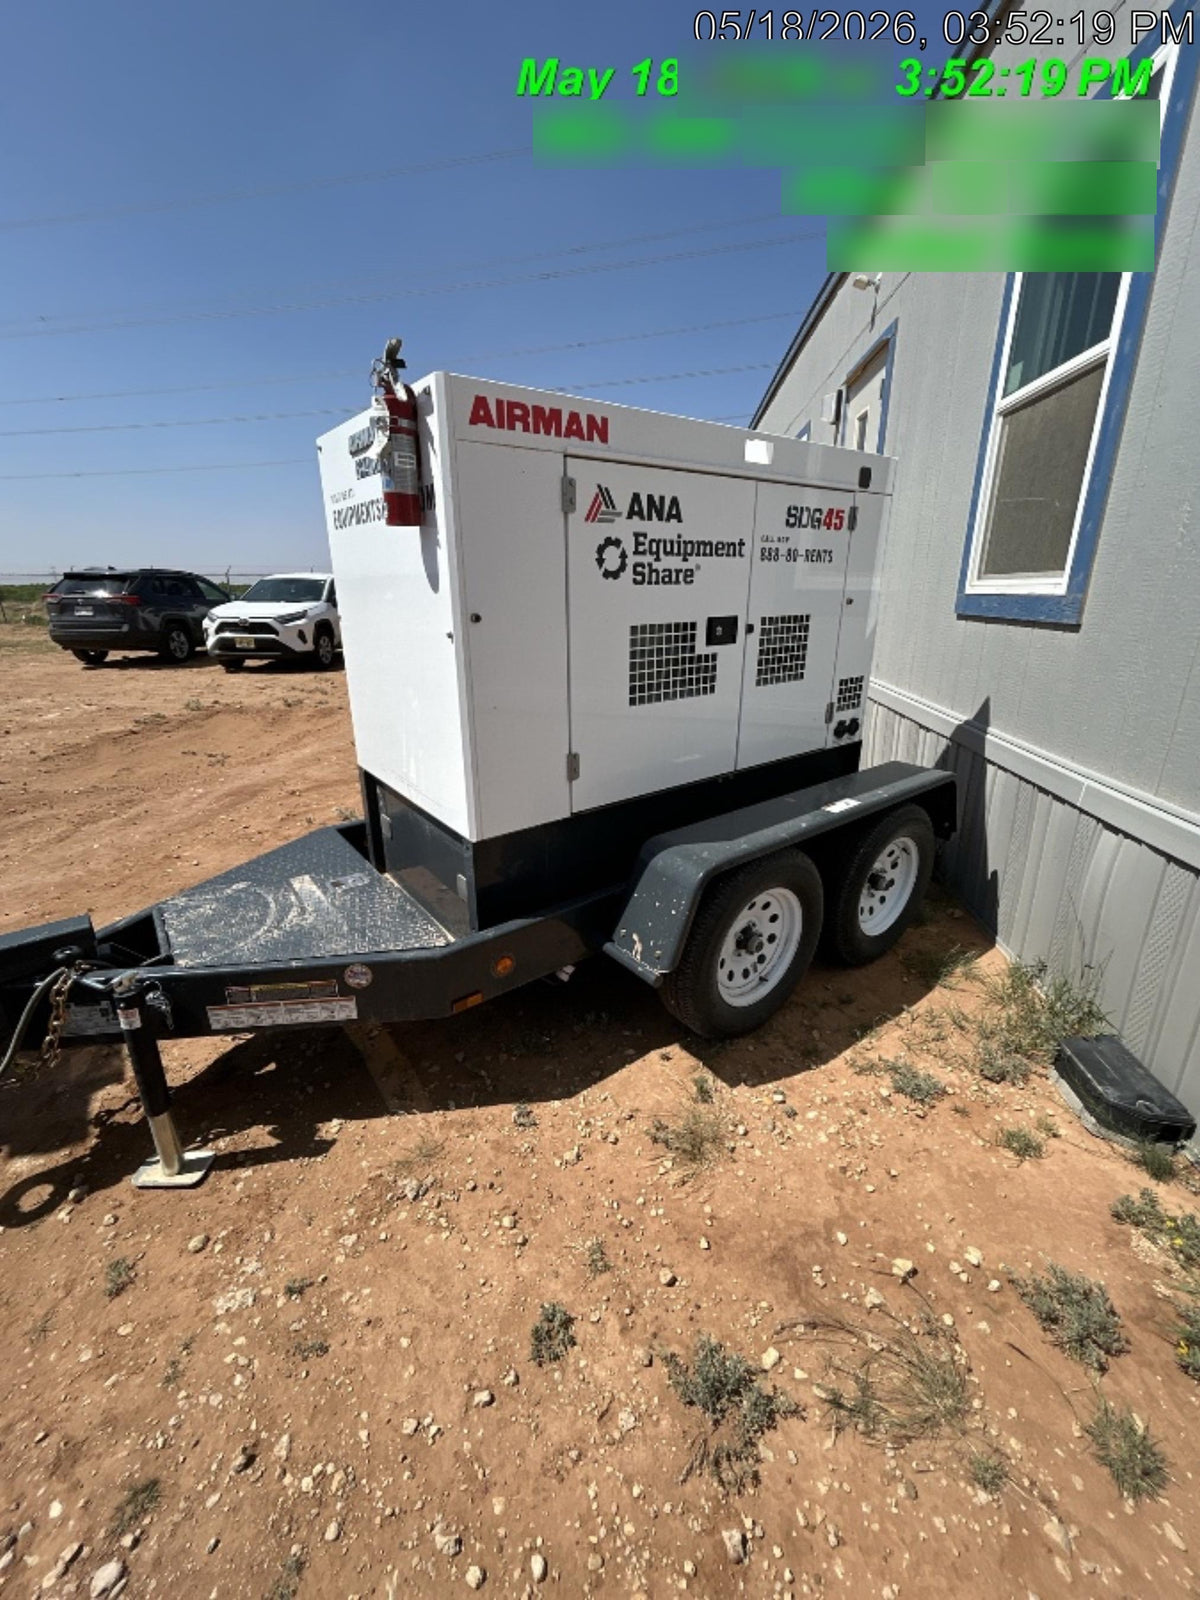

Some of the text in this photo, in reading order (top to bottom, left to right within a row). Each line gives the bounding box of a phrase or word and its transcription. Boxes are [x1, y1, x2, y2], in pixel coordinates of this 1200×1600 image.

[469, 394, 609, 444] AIRMAN
[625, 491, 683, 523] ANA
[785, 504, 845, 531] SDG45
[632, 531, 745, 562] Equipment
[632, 561, 695, 586] Share
